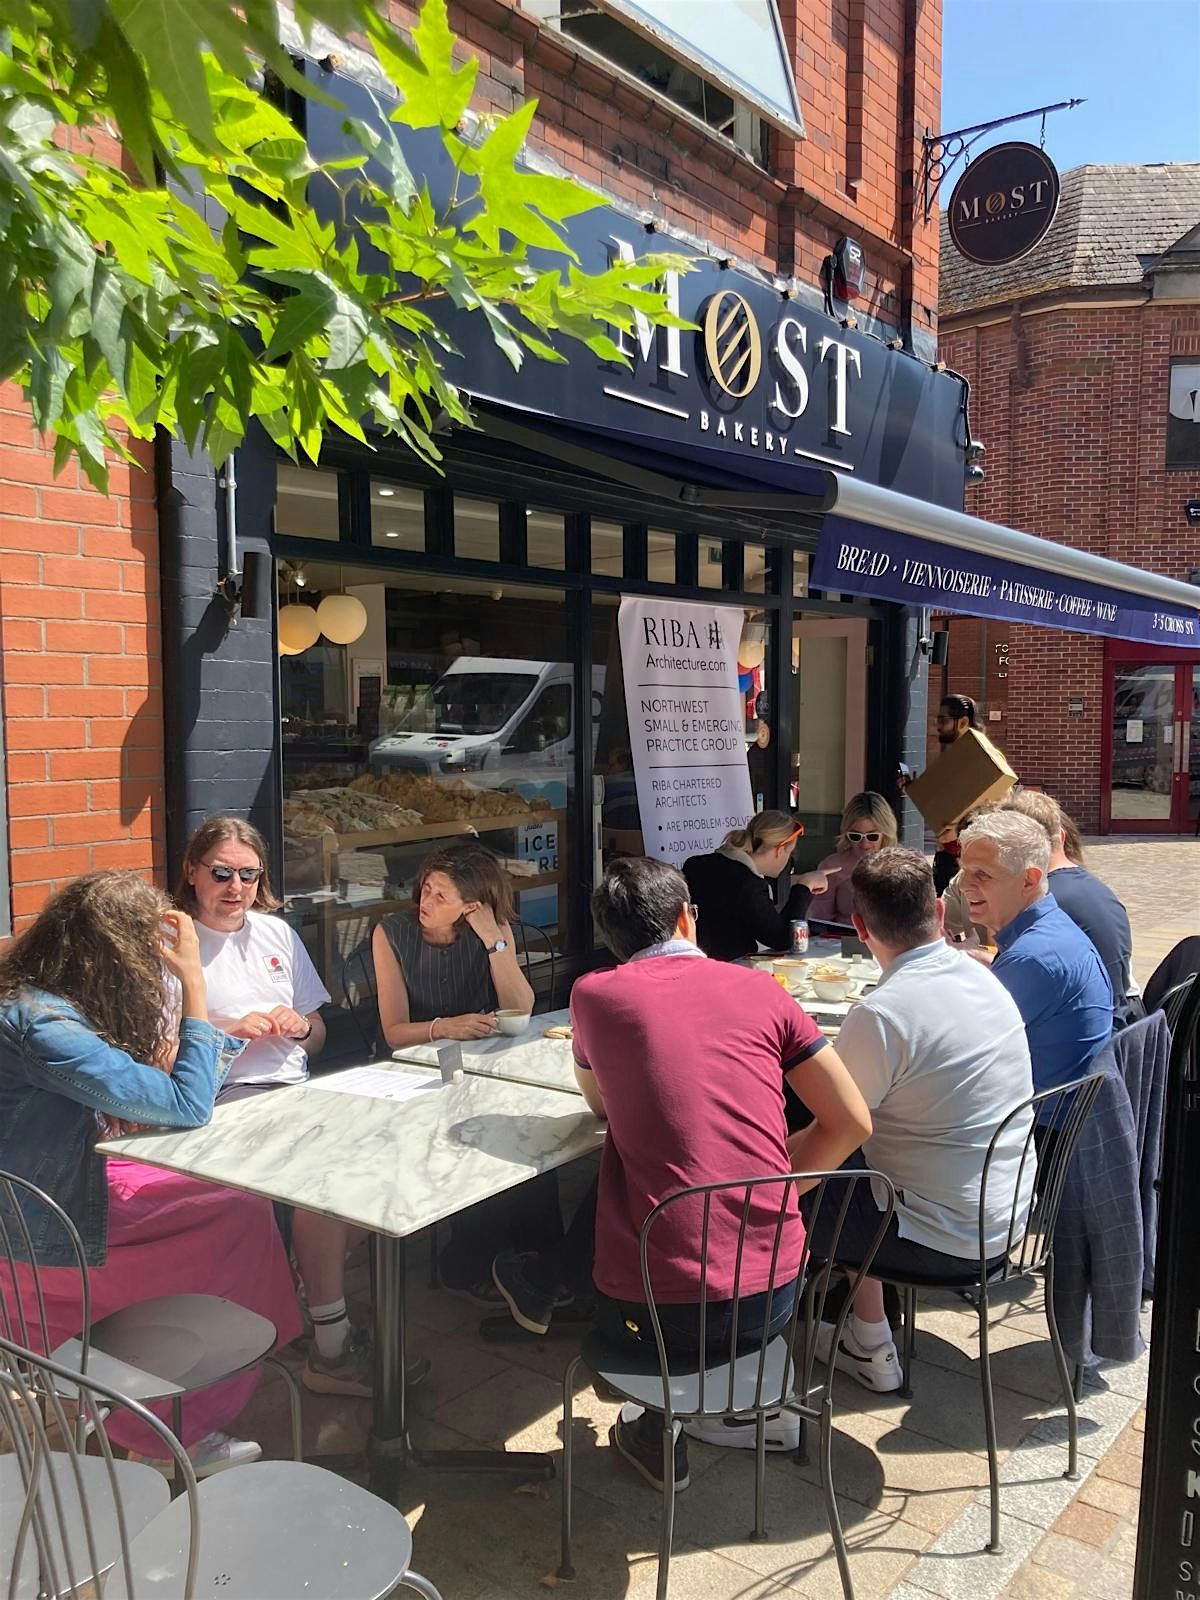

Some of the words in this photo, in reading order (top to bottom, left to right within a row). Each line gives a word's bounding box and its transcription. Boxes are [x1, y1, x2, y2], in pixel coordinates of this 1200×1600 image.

[960, 180, 1049, 222] MOST
[609, 235, 862, 436] MOST
[700, 411, 789, 454] BAKERY
[837, 544, 890, 577] BREAD
[902, 560, 992, 598] VIENNOISERIE
[1000, 579, 1054, 610] PATISSERIE
[1058, 593, 1093, 618] COFFEE
[1095, 602, 1119, 622] WINE
[642, 616, 701, 649] RIBA
[1185, 620, 1194, 635] ST
[646, 652, 729, 673] Architecture.com
[641, 699, 710, 713] NORTHWEST
[644, 719, 680, 733] SMALL
[681, 719, 689, 733] &
[692, 719, 743, 733] EMERGING
[646, 738, 699, 752] PRACTICE
[701, 738, 738, 752] GROUP
[652, 780, 671, 791] RIBA
[673, 778, 722, 791] CHARTERED
[666, 820, 681, 833] ARE
[525, 833, 556, 854] ICE
[668, 840, 686, 853] ADD
[688, 838, 715, 851] VALUE
